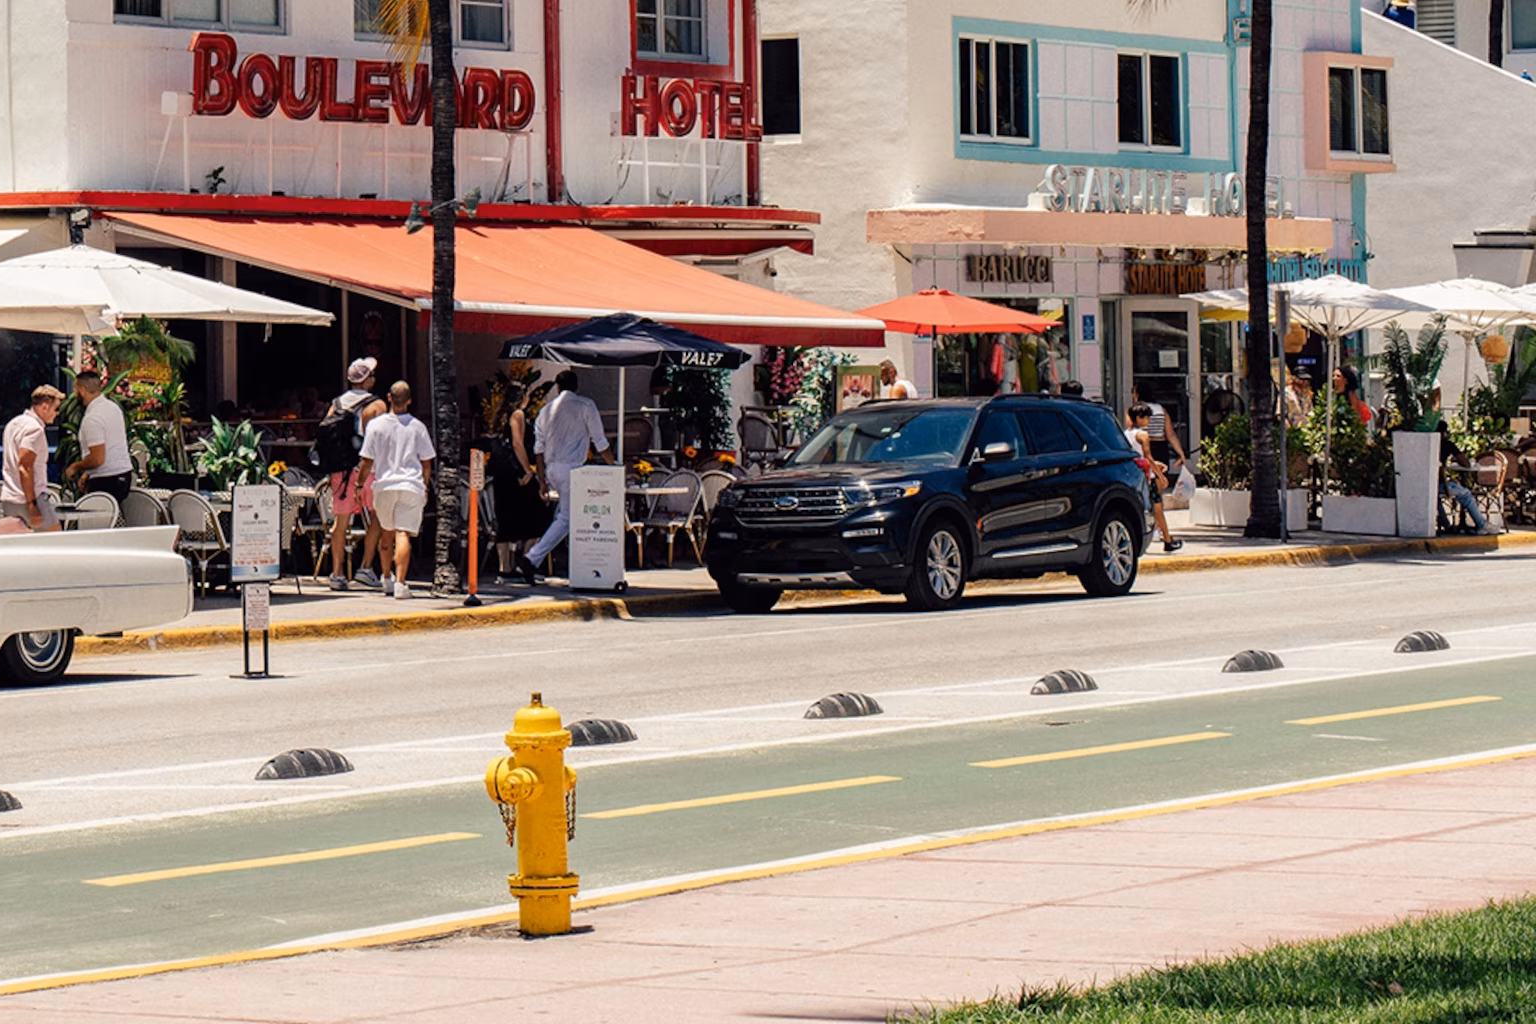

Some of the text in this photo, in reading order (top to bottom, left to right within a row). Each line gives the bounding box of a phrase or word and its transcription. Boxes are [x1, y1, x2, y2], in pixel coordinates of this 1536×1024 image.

[621, 76, 763, 142] HOTEL
[1044, 163, 1295, 219] STARLITE HOEL
[509, 343, 533, 358] VALET
[680, 351, 725, 367] VALET
